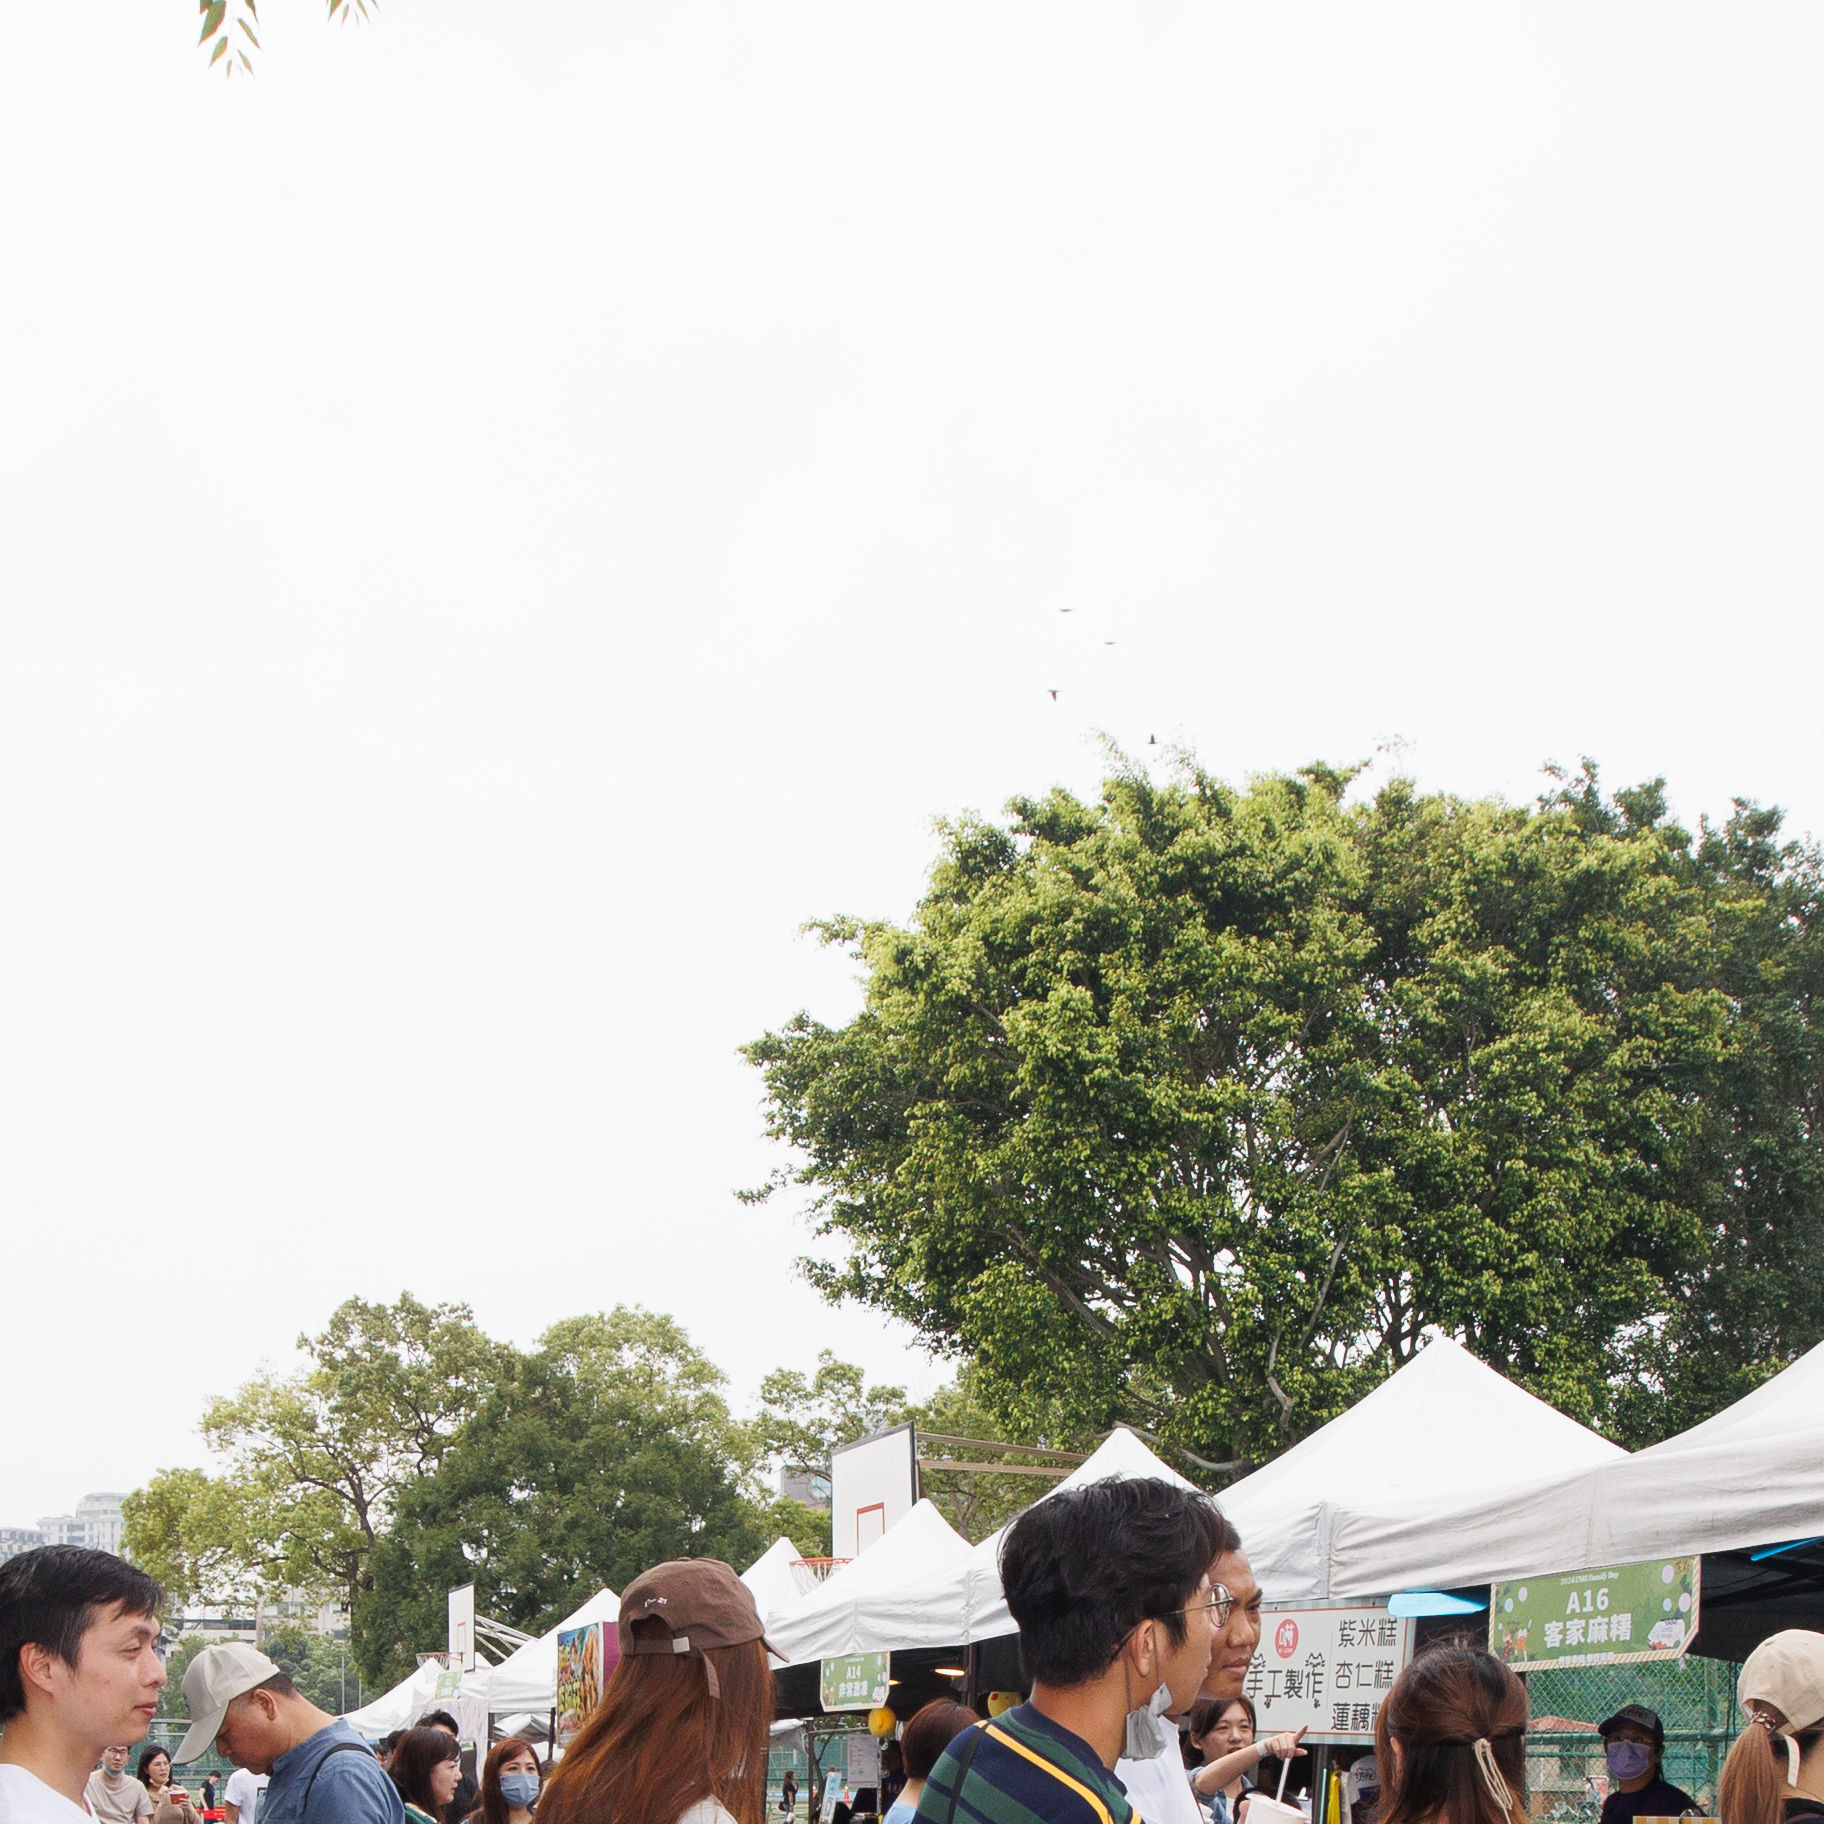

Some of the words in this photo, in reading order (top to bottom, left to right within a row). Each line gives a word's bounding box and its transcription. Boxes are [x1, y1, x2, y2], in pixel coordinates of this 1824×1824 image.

[1565, 1587, 1609, 1615] A16
[1337, 1617, 1398, 1648] 紫米糕
[1543, 1612, 1632, 1648] 客家麻糬
[846, 1665, 862, 1679] A14
[1246, 1667, 1325, 1700] 手工製作
[1334, 1659, 1395, 1690] 杏仁糕
